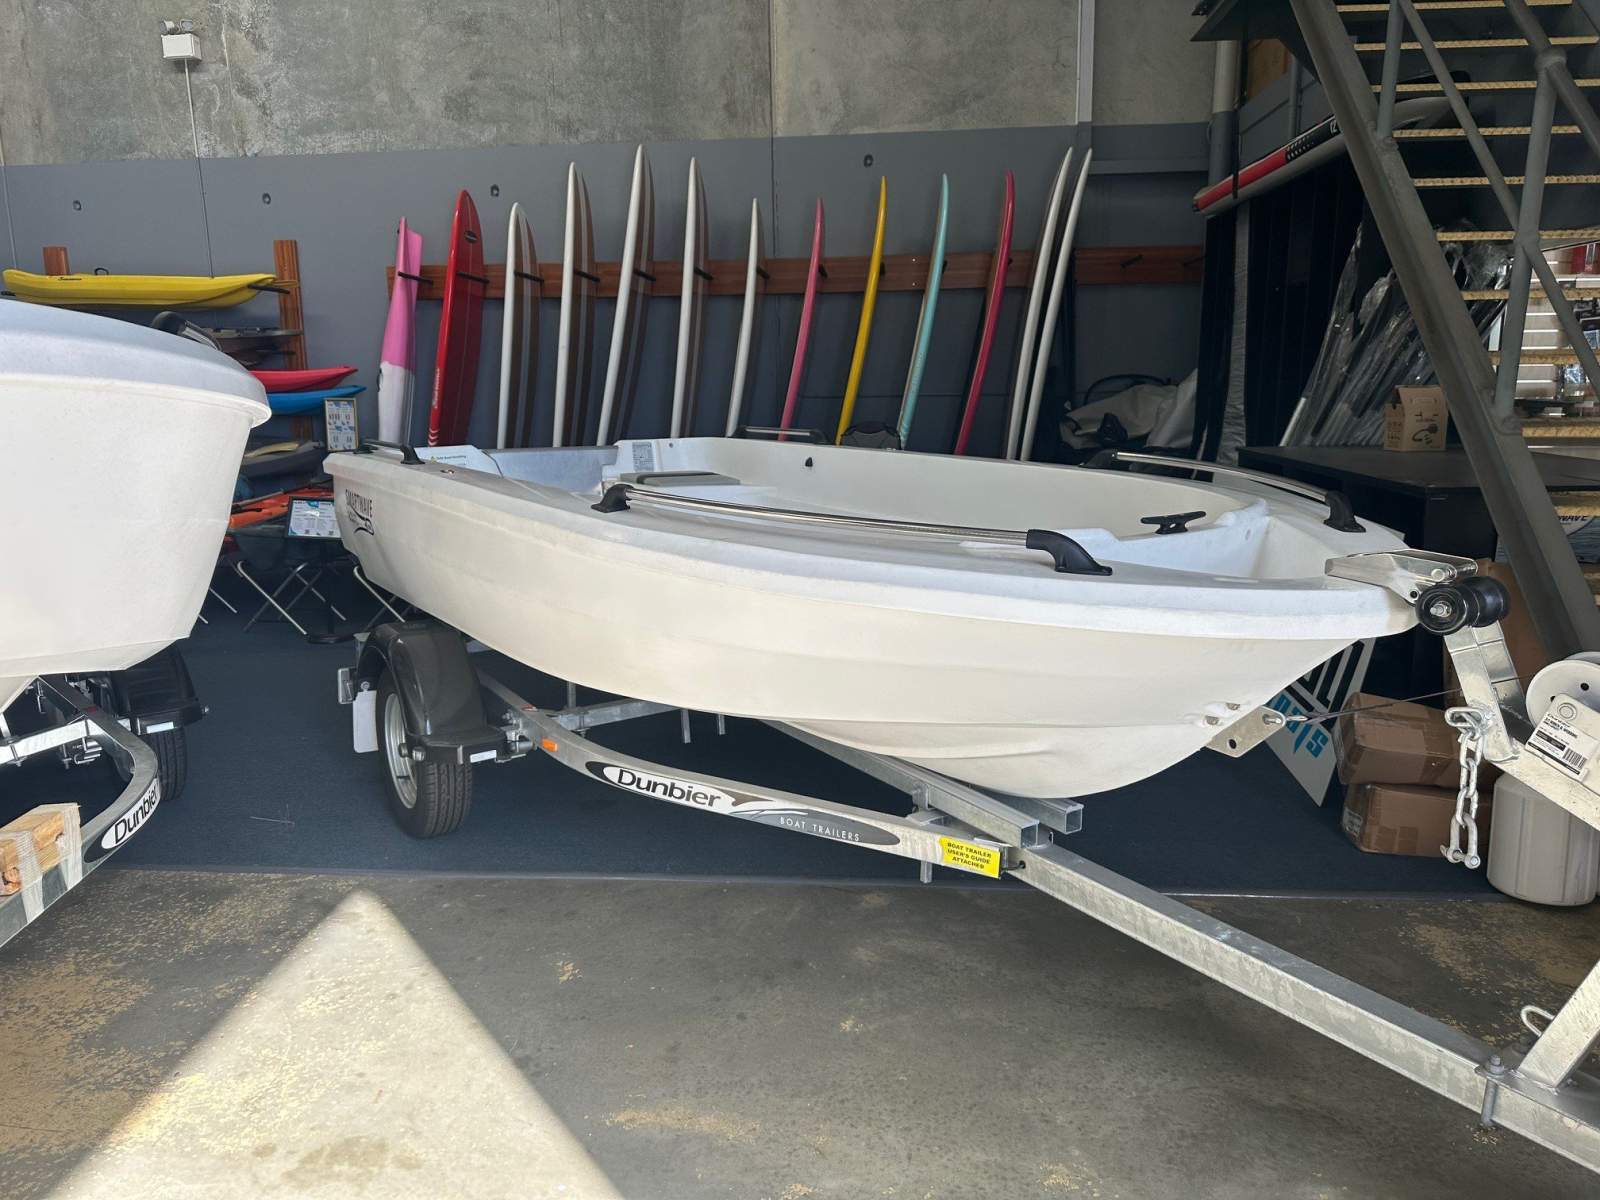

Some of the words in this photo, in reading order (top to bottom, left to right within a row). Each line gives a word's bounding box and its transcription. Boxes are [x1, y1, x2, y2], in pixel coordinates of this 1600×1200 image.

[618, 769, 721, 807] Dunbier
[115, 785, 158, 845] Dunbier
[780, 816, 806, 830] BOAT
[812, 824, 860, 842] TRAILERS
[948, 849, 969, 858] USER'S
[971, 855, 991, 864] GUIDE
[952, 857, 984, 868] ATTACHED
[966, 847, 991, 858] TRAILER
